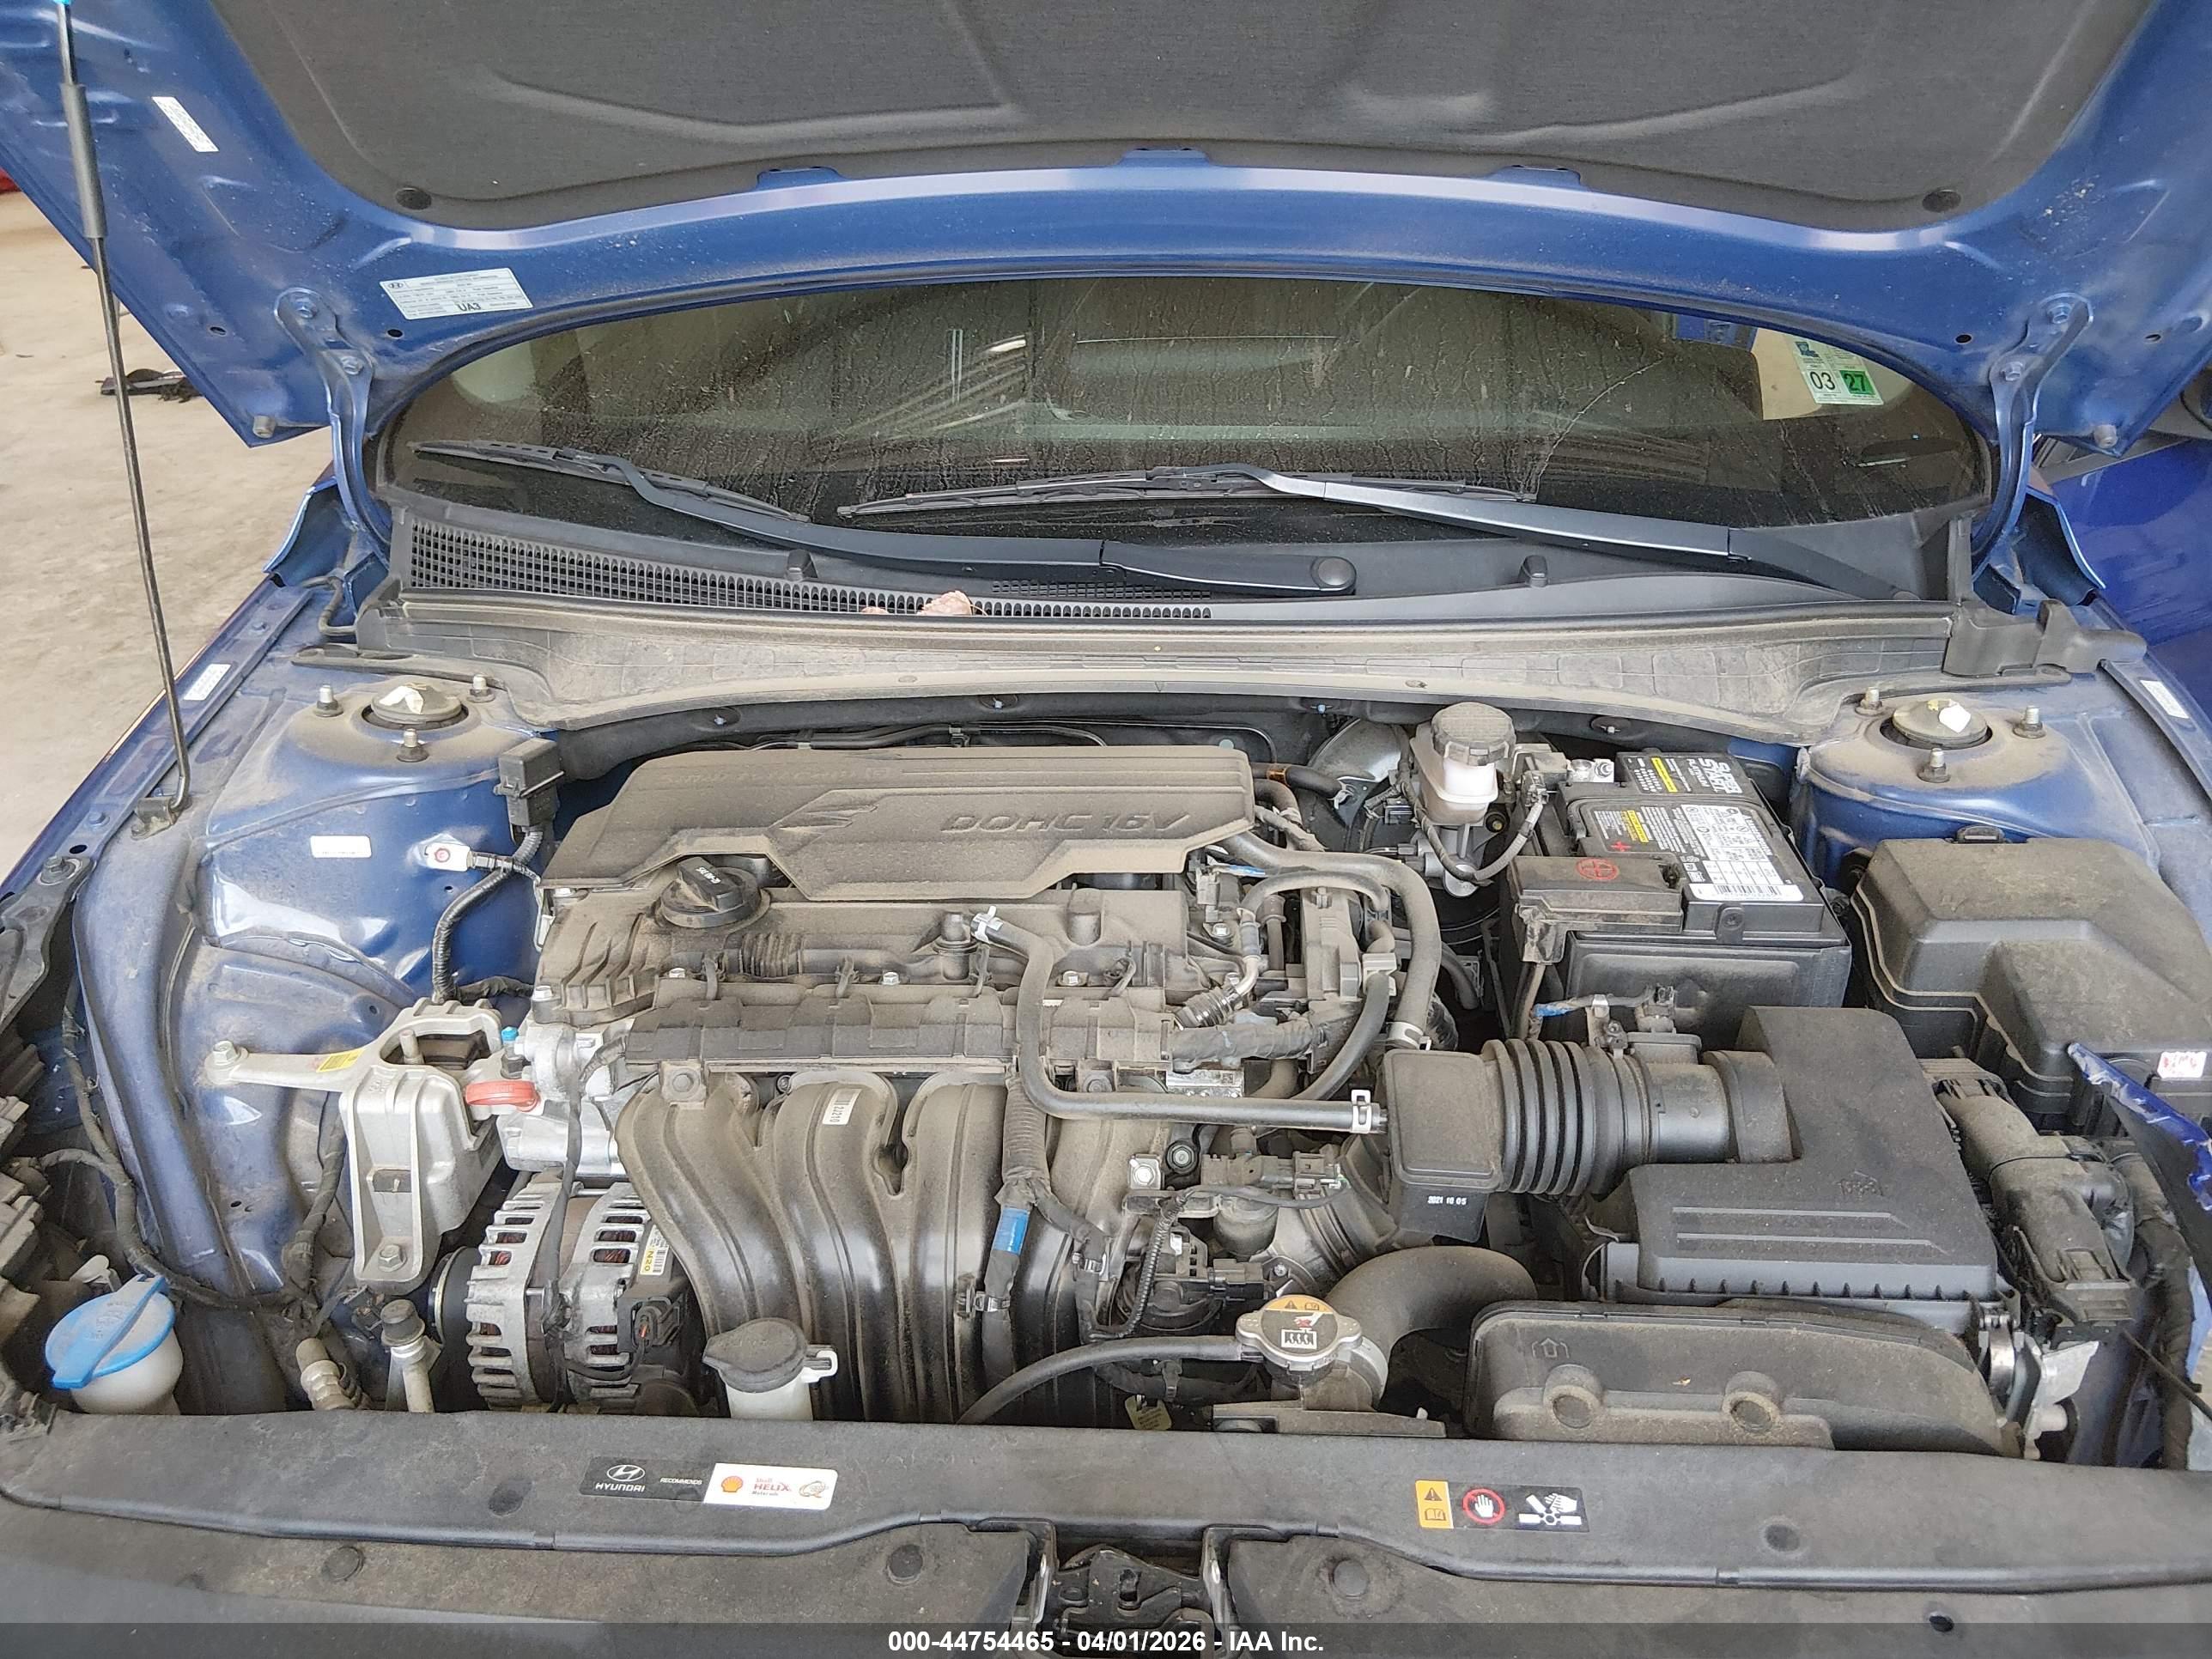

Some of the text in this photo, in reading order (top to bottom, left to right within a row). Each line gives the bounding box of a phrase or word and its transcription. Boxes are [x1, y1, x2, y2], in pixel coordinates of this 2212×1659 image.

[458, 302, 481, 312] UA3
[1809, 371, 1836, 391] 03
[1844, 373, 1867, 392] 27
[1686, 758, 1711, 787] PLATINUM
[1698, 757, 1727, 793] START
[1717, 762, 1743, 793] SUPER
[940, 814, 1190, 833] DOHC 16V
[830, 1105, 845, 1123] 22210
[1455, 1197, 1468, 1206] 05
[644, 1250, 655, 1272] N20
[595, 1477, 702, 1492] HYUNDAI RECOMMENDS
[754, 1482, 790, 1492] HELIX
